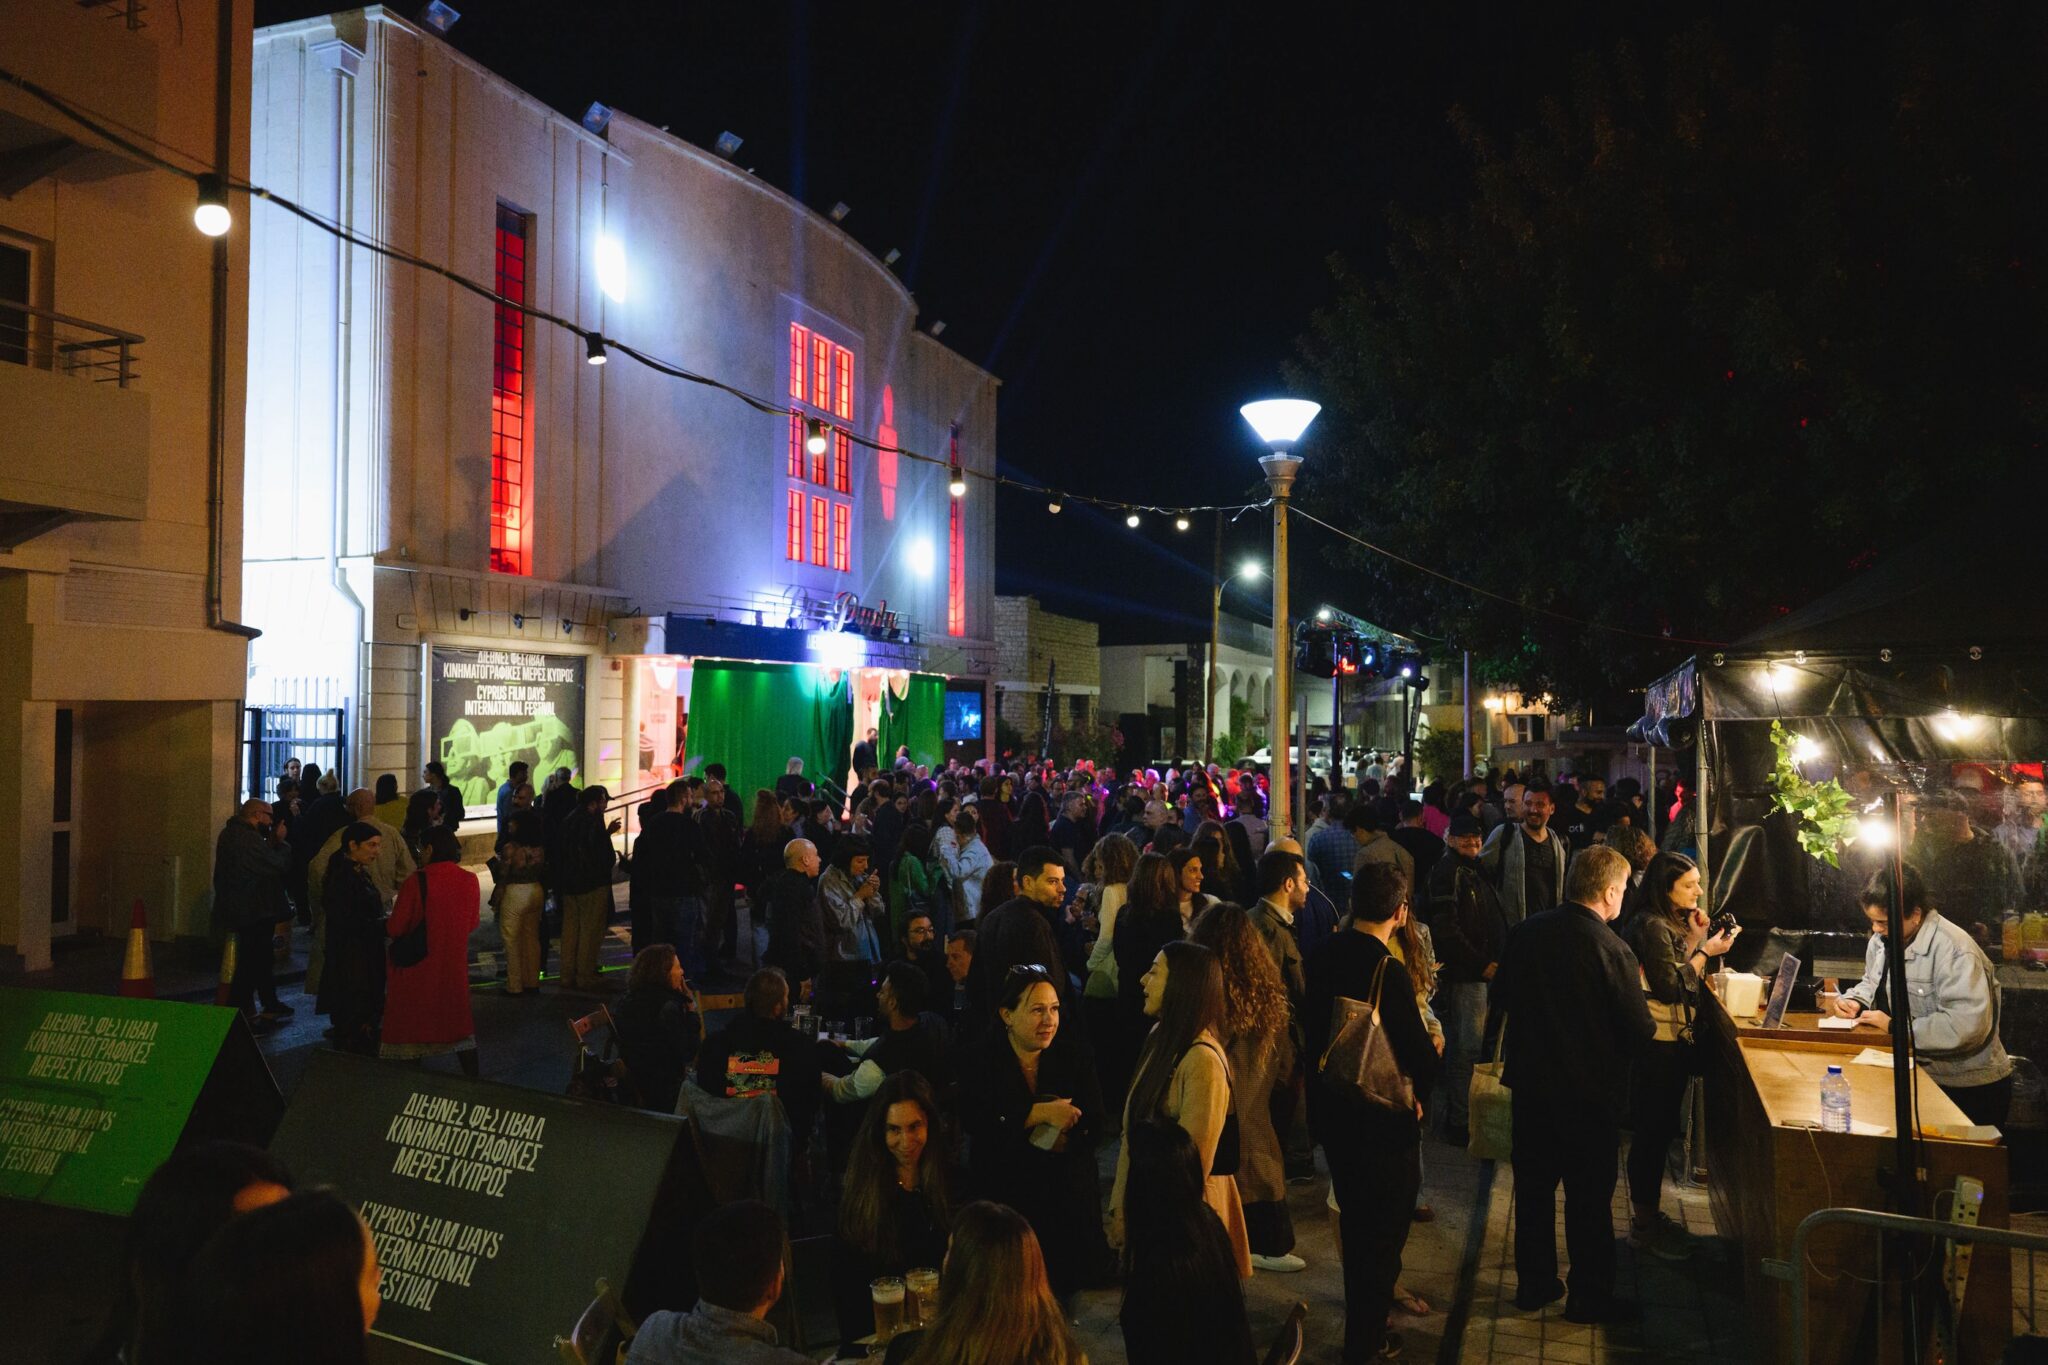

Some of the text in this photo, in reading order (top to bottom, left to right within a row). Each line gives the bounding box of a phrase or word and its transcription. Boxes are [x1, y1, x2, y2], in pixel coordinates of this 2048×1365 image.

[443, 662, 574, 683] ΚΙΝΗΜΑΤΟΓΡΑΦΙΚΕΣ ΜΕΡΕΣ ΚΥΠΡΟΣ
[464, 700, 555, 716] INTERNATIONAL FESTIVAL
[476, 685, 546, 701] CYPRUS FILM DAYS
[24, 1030, 155, 1065] ΚΙΝΗΜΑΤΟΓΡΑΦΙΚΕΣ
[28, 1054, 129, 1086] ΜΕΡΕΣ ΚΥΠΡΟΣ
[45, 1104, 82, 1127] FILM
[78, 1108, 117, 1132] DAYS
[385, 1115, 543, 1172] ΚΙΝΗΜΑΤΟΓΡΑΦΙΚΕΣ
[1, 1146, 61, 1176] FESTIVAL
[391, 1146, 513, 1198] ΜΕΡΕΣ ΚΥΠΡΟΣ
[416, 1215, 461, 1248] FILM
[456, 1225, 504, 1259] DAYS
[371, 1231, 478, 1288] TERNATIONAL
[375, 1266, 440, 1312] ESTIVAL
